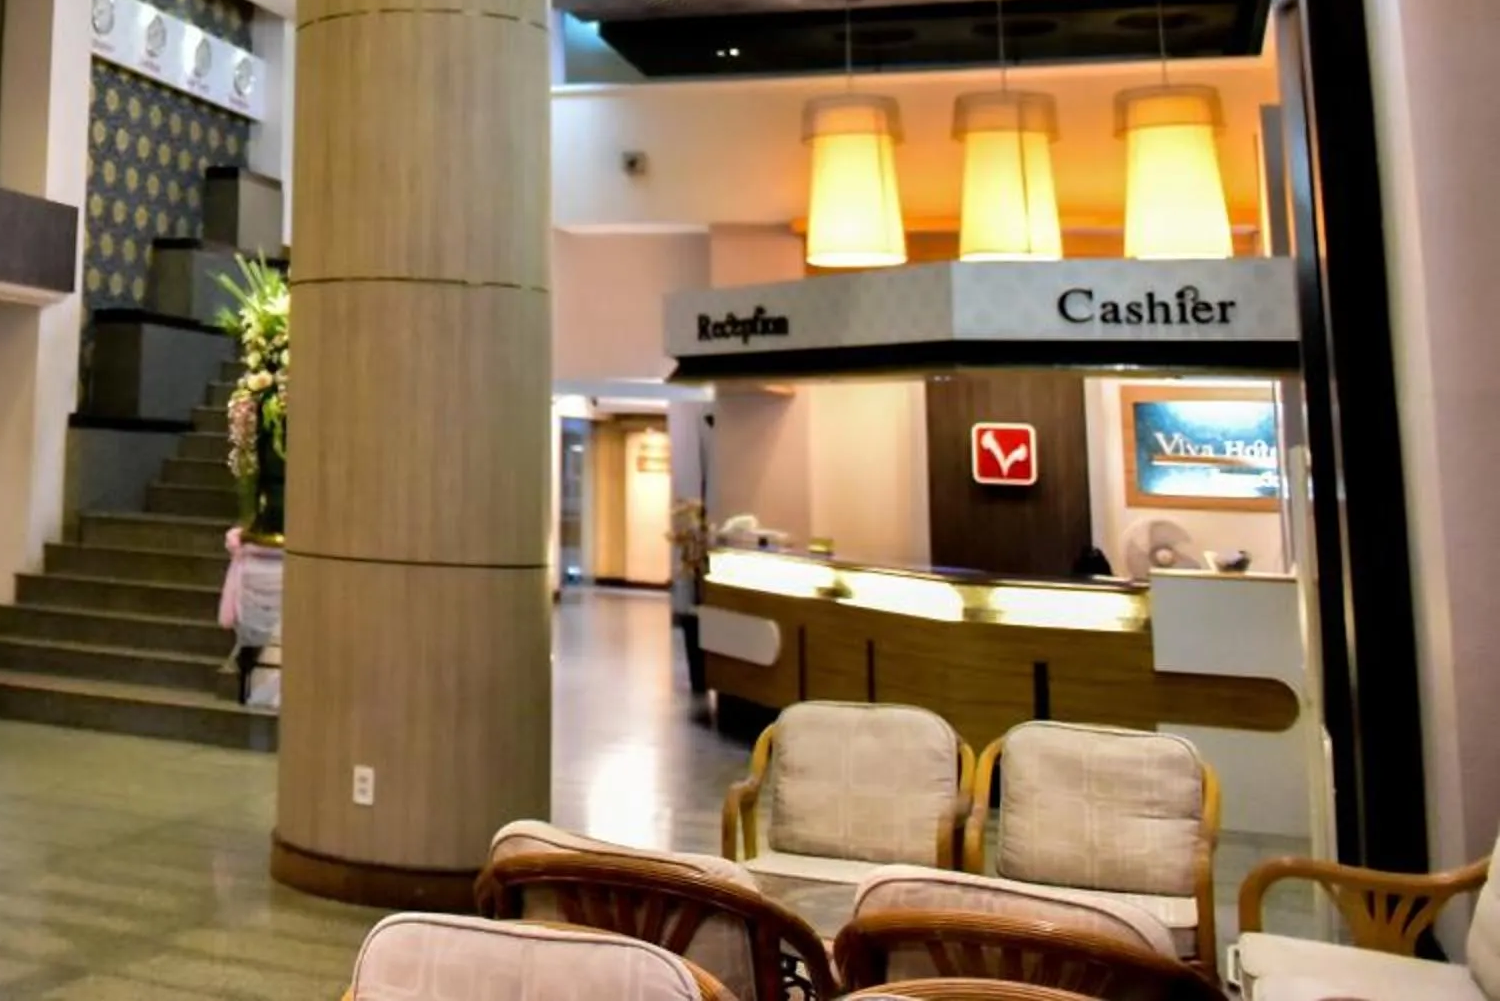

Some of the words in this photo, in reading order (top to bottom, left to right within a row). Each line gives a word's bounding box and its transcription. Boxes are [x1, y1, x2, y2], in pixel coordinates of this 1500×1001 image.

[1057, 285, 1236, 325] Cashier
[697, 305, 789, 346] Reception
[1154, 431, 1214, 457] Viva
[1224, 439, 1277, 458] Hote
